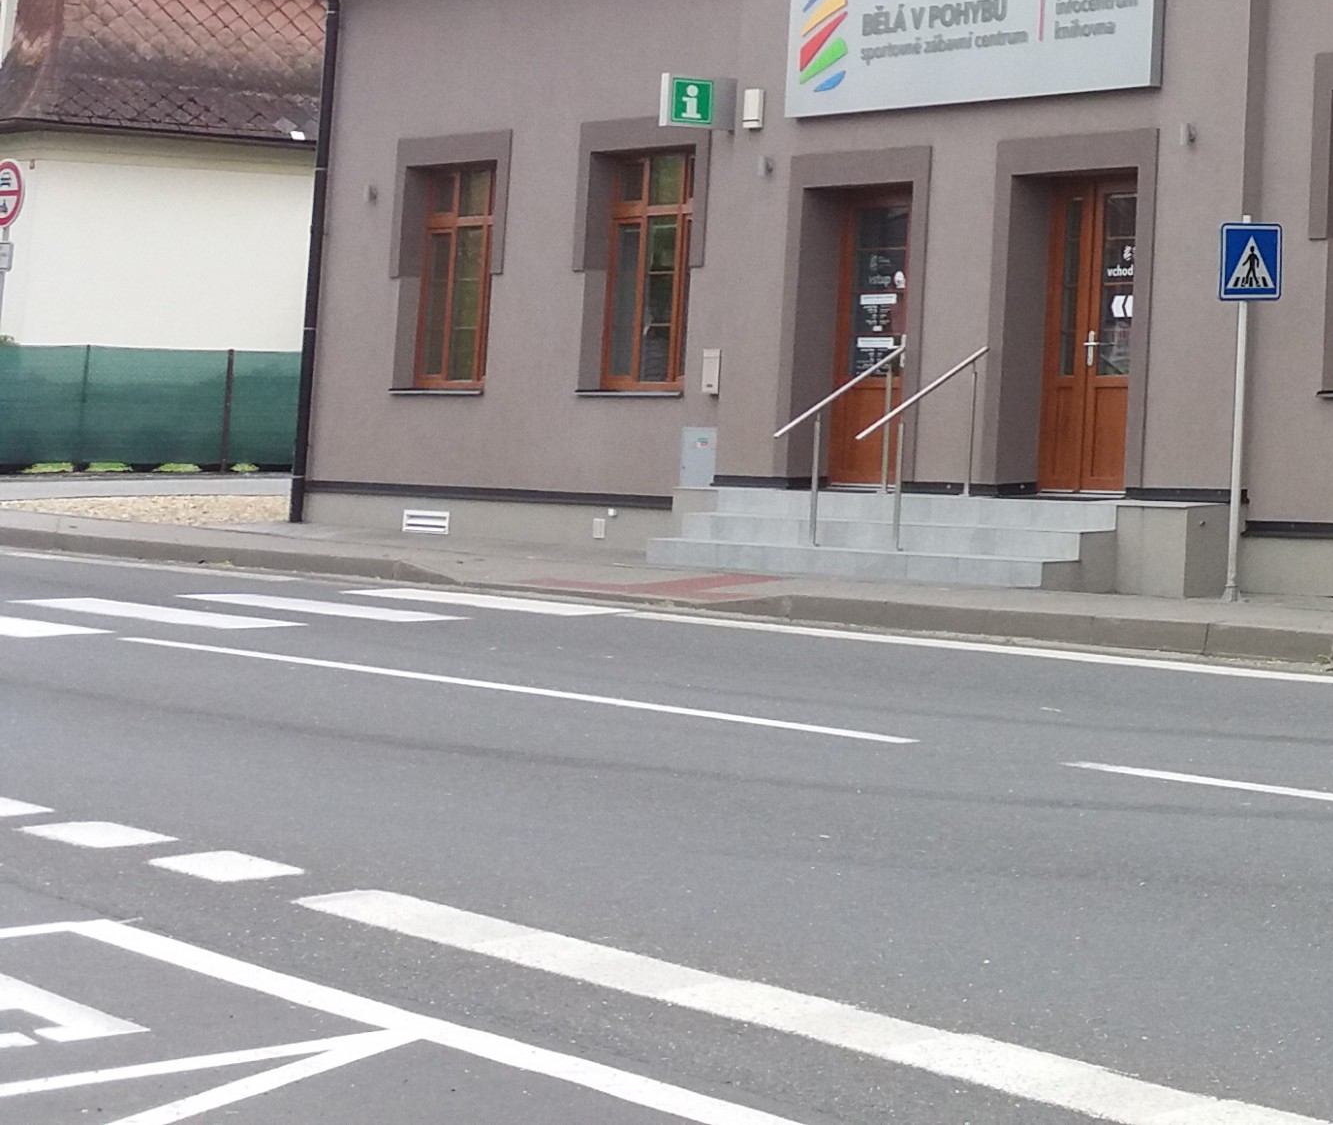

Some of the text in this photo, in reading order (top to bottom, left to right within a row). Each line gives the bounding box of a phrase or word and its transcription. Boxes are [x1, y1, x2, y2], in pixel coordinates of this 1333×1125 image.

[862, 4, 907, 36] BĚLÁ
[911, 6, 925, 30] V
[1054, 18, 1116, 40] knihovna
[974, 29, 1029, 48] centrum
[1107, 264, 1134, 277] vchod
